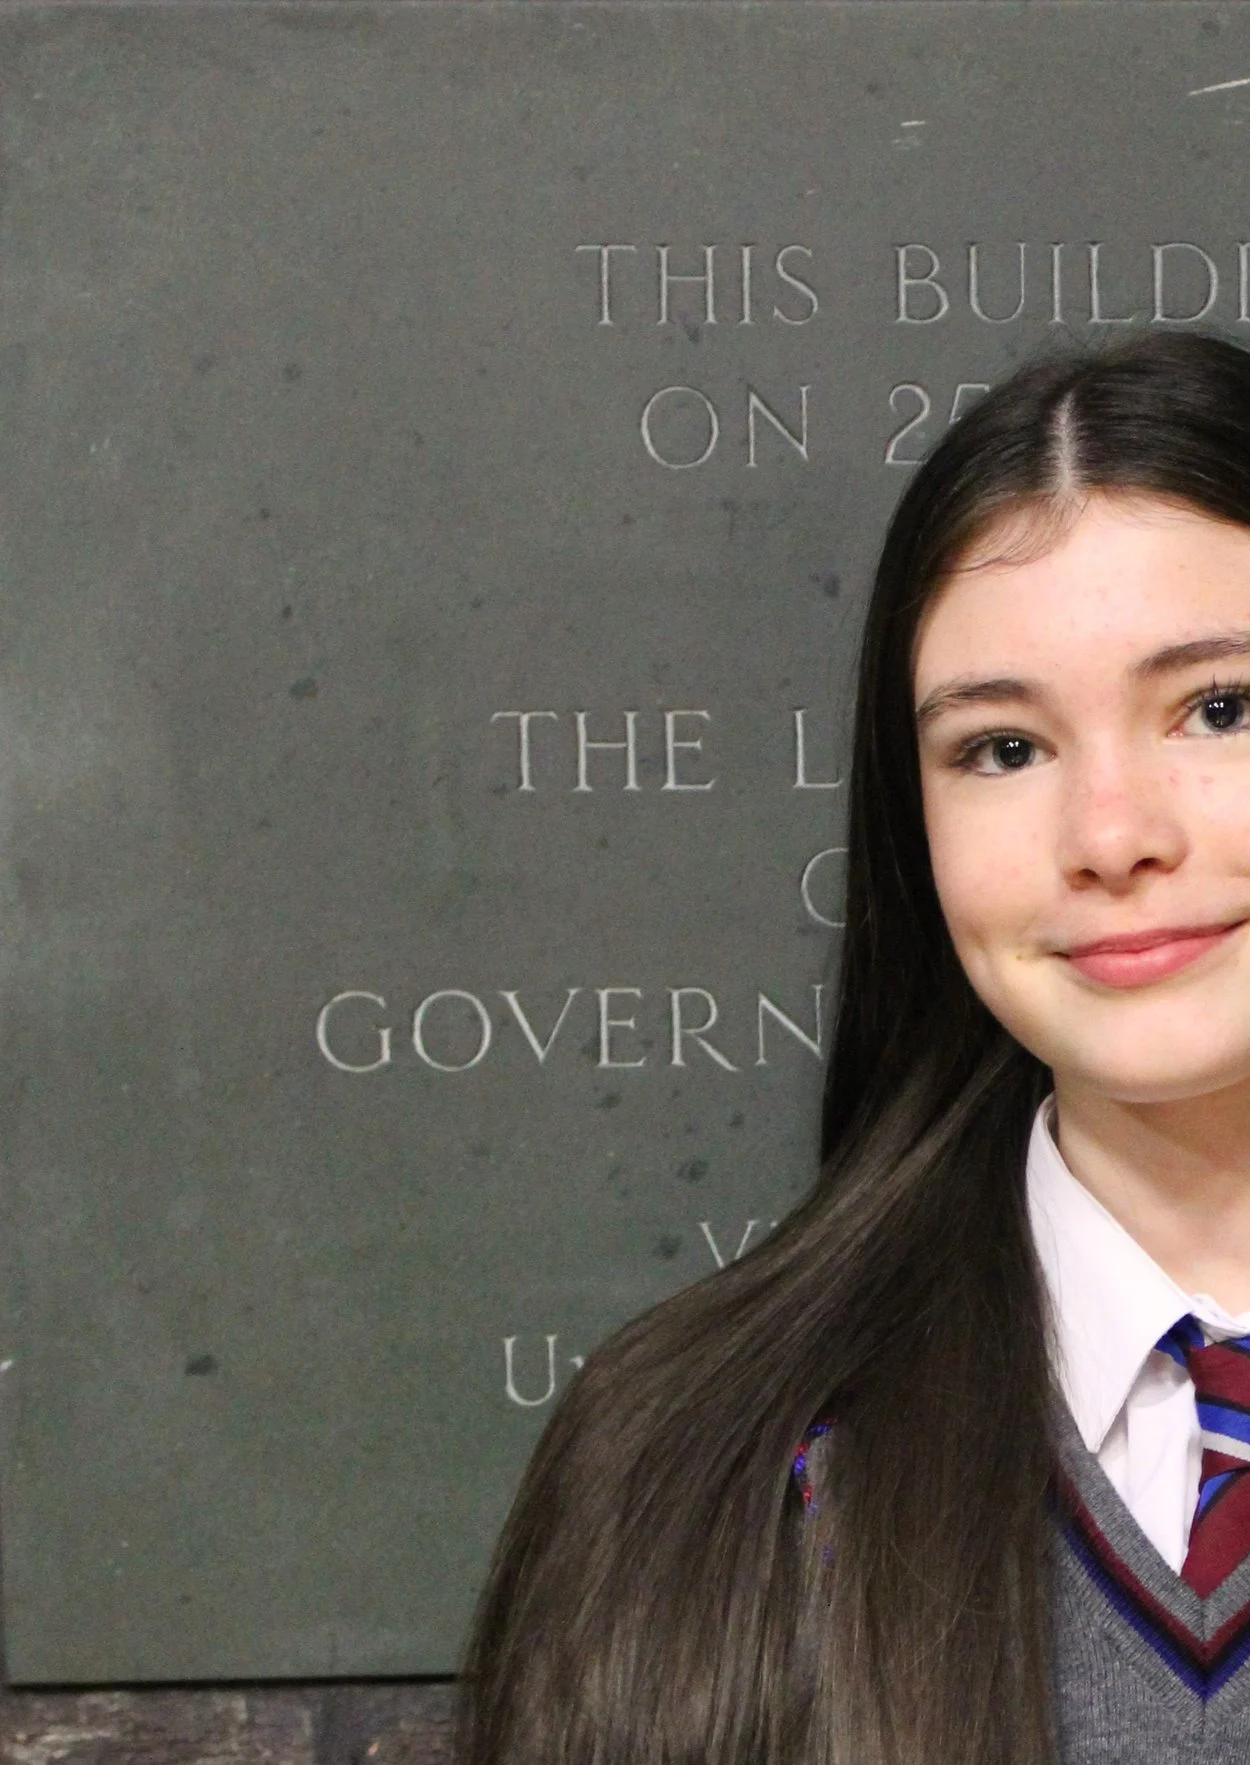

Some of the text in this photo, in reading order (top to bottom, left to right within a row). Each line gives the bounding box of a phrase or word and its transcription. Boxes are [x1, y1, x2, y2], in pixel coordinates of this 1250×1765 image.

[575, 243, 820, 326] THIS
[640, 385, 811, 470] ON
[490, 709, 716, 793] THE
[315, 983, 825, 1074] GOVERN
